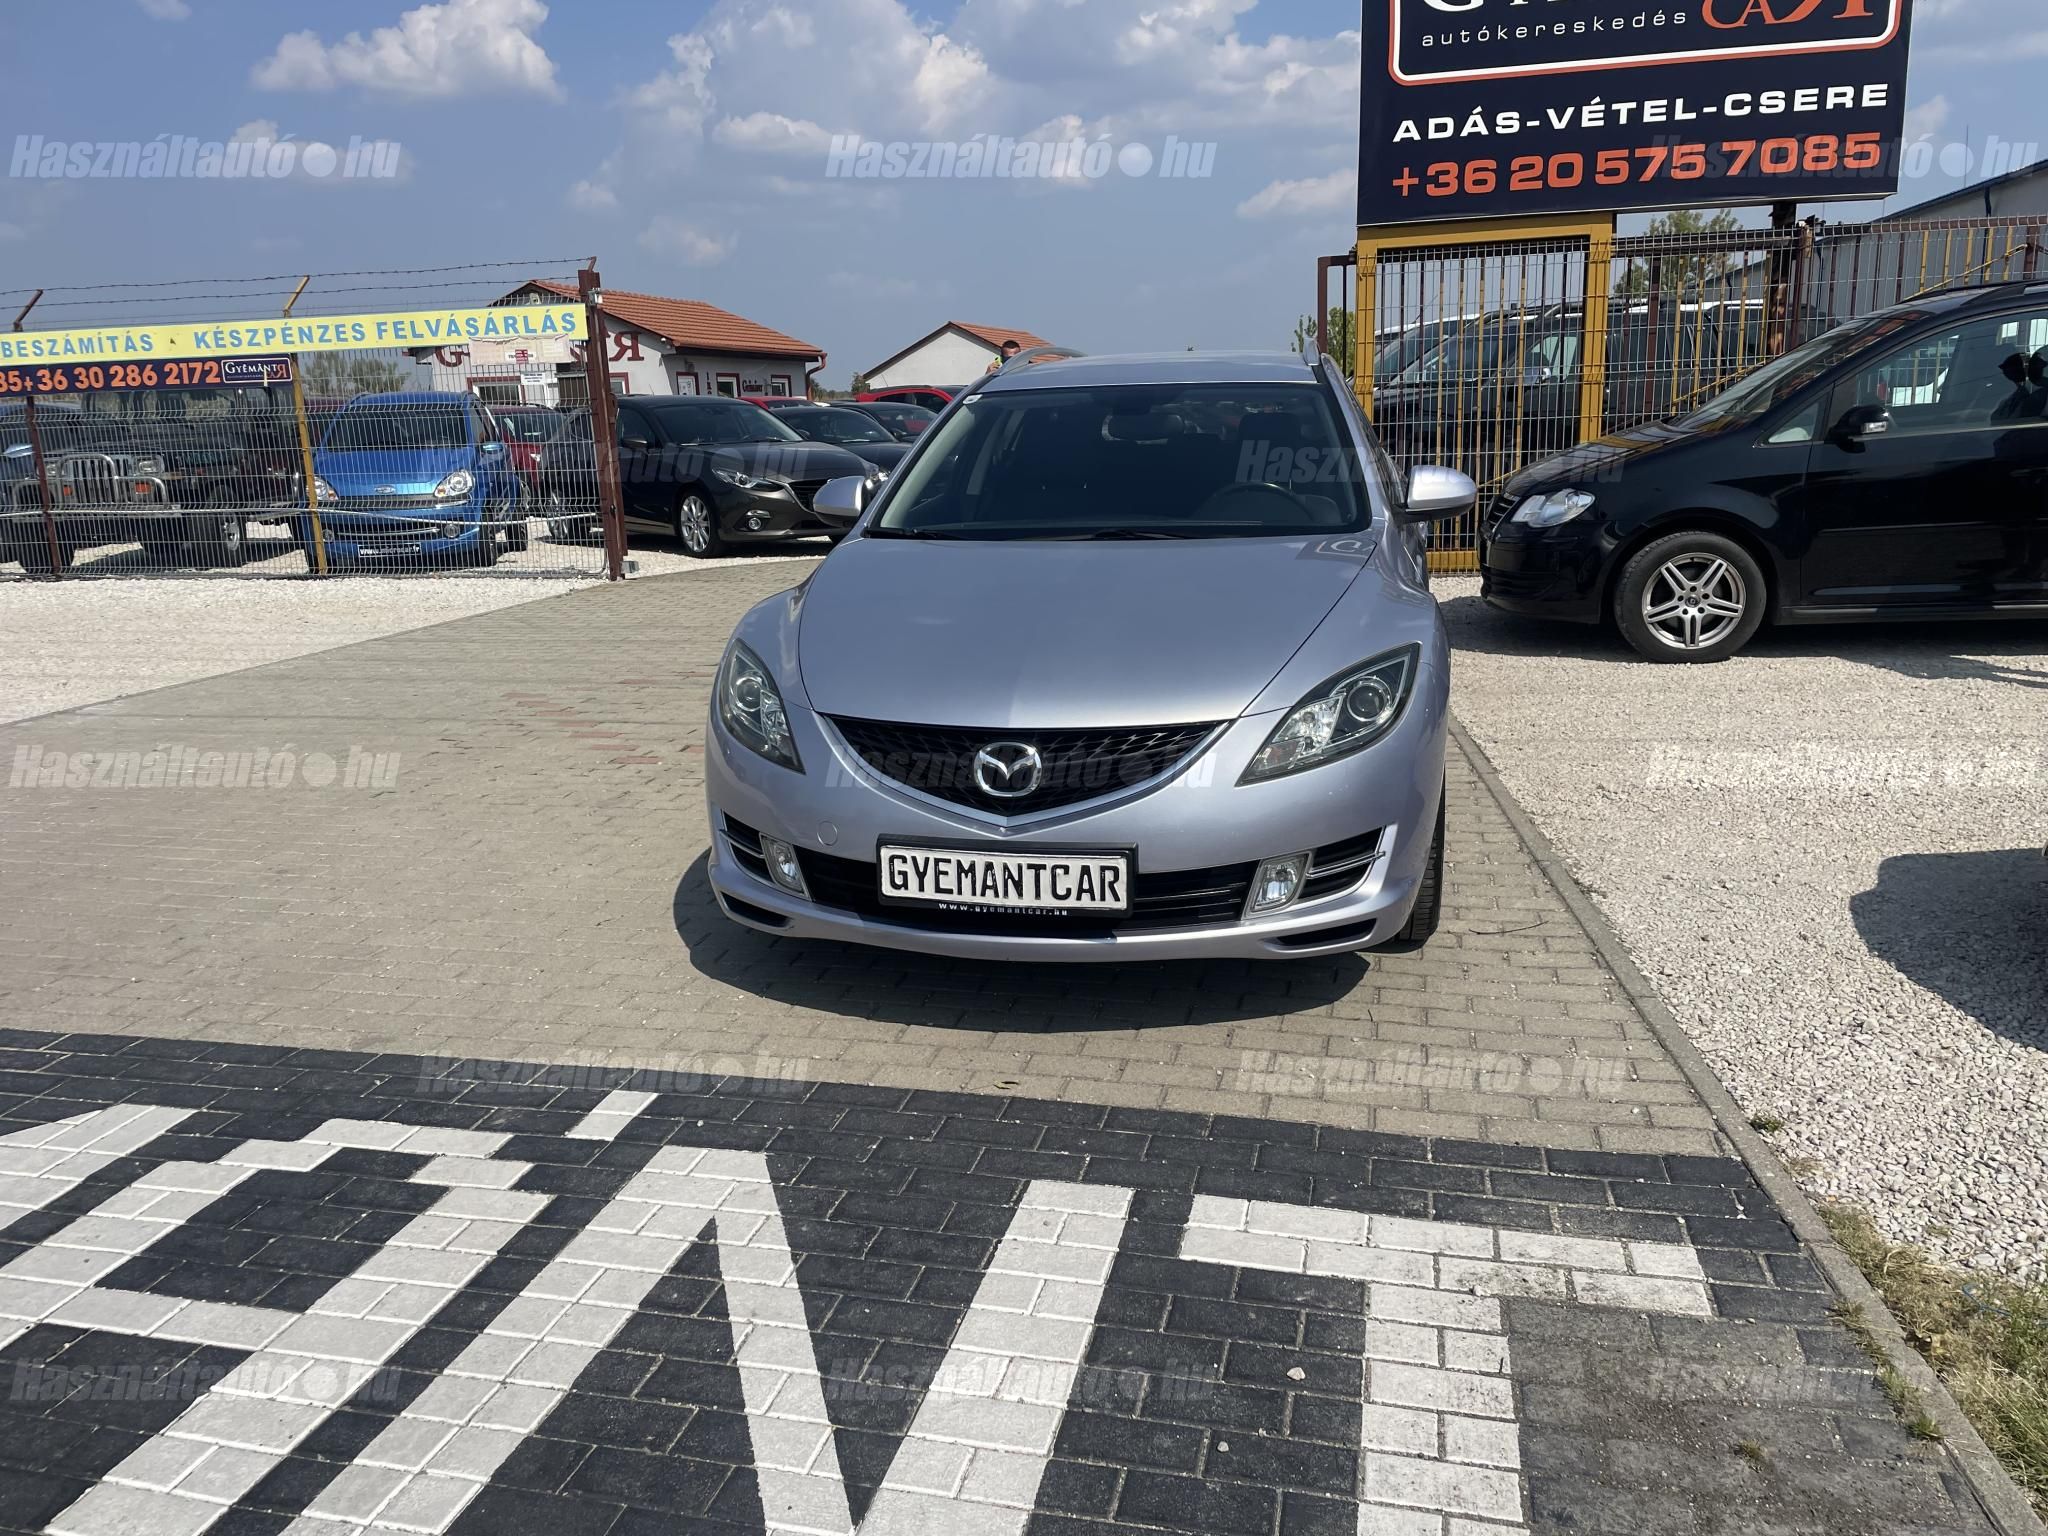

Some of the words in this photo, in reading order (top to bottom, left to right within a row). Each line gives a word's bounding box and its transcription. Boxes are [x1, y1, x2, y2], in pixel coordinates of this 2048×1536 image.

[1421, 10, 1687, 47] autókereskedés
[1392, 83, 1889, 143] ADÁS-VÉTEL-CSERE
[1392, 160, 1497, 197] +36
[1510, 152, 1583, 191] 20
[1594, 143, 1706, 184] 575
[1720, 132, 1881, 176] 7085
[1, 331, 154, 358] BESZÁMÍTÁS
[194, 319, 366, 350] KÉSZPÉNZES
[377, 309, 576, 341] FELVÁSÁRLÁS
[74, 367, 104, 389] 30
[109, 364, 158, 387] 286
[163, 360, 220, 385] 2172
[888, 854, 1121, 902] GYEMANTCAR
[938, 902, 1069, 916] www.gyemantcar.hu
